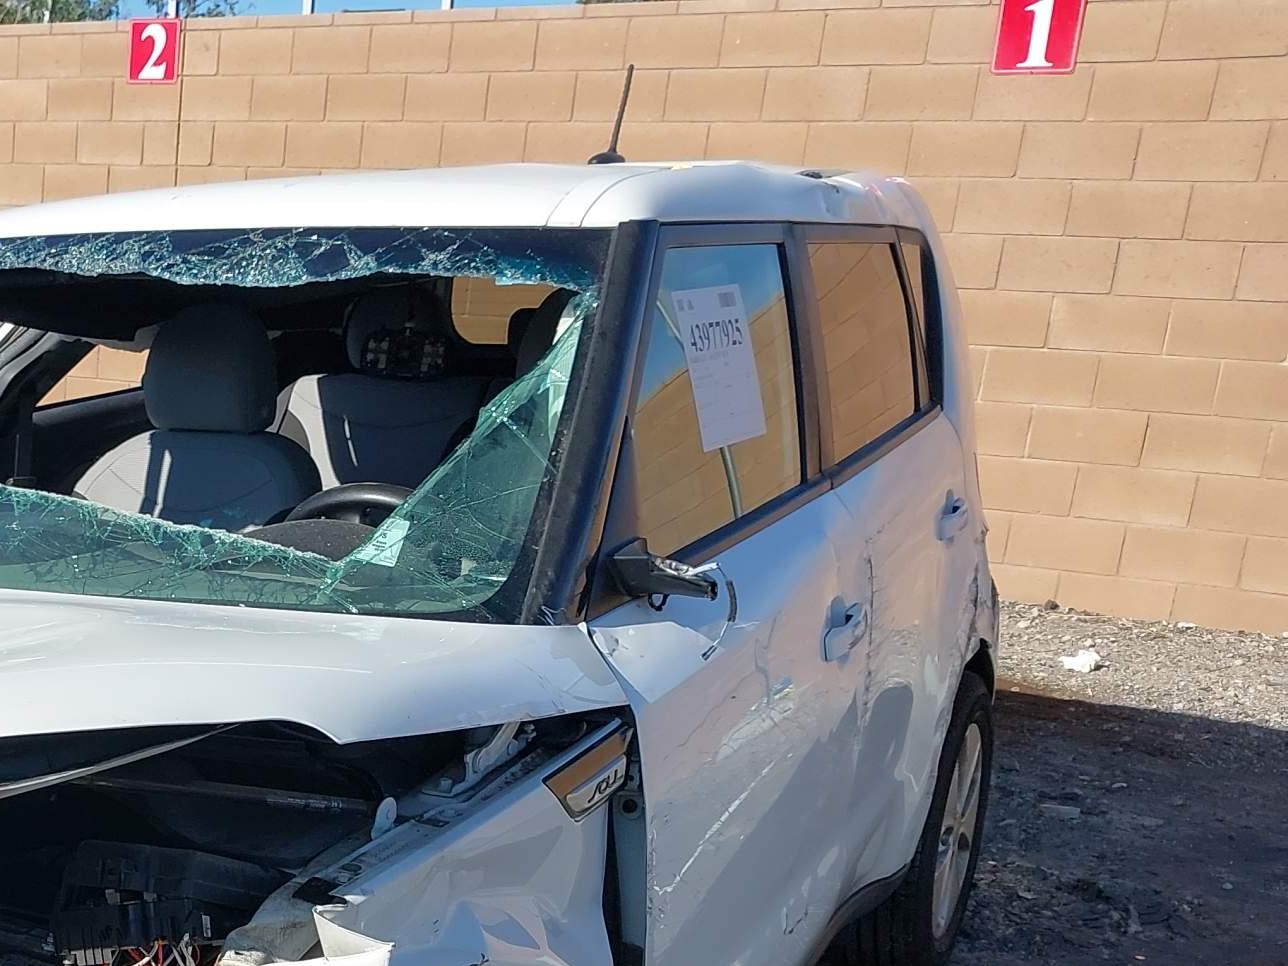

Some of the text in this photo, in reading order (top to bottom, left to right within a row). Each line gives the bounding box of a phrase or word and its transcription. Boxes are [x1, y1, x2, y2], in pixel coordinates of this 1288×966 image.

[137, 22, 168, 81] 2
[1015, 0, 1055, 68] 1
[690, 318, 743, 353] 43977925
